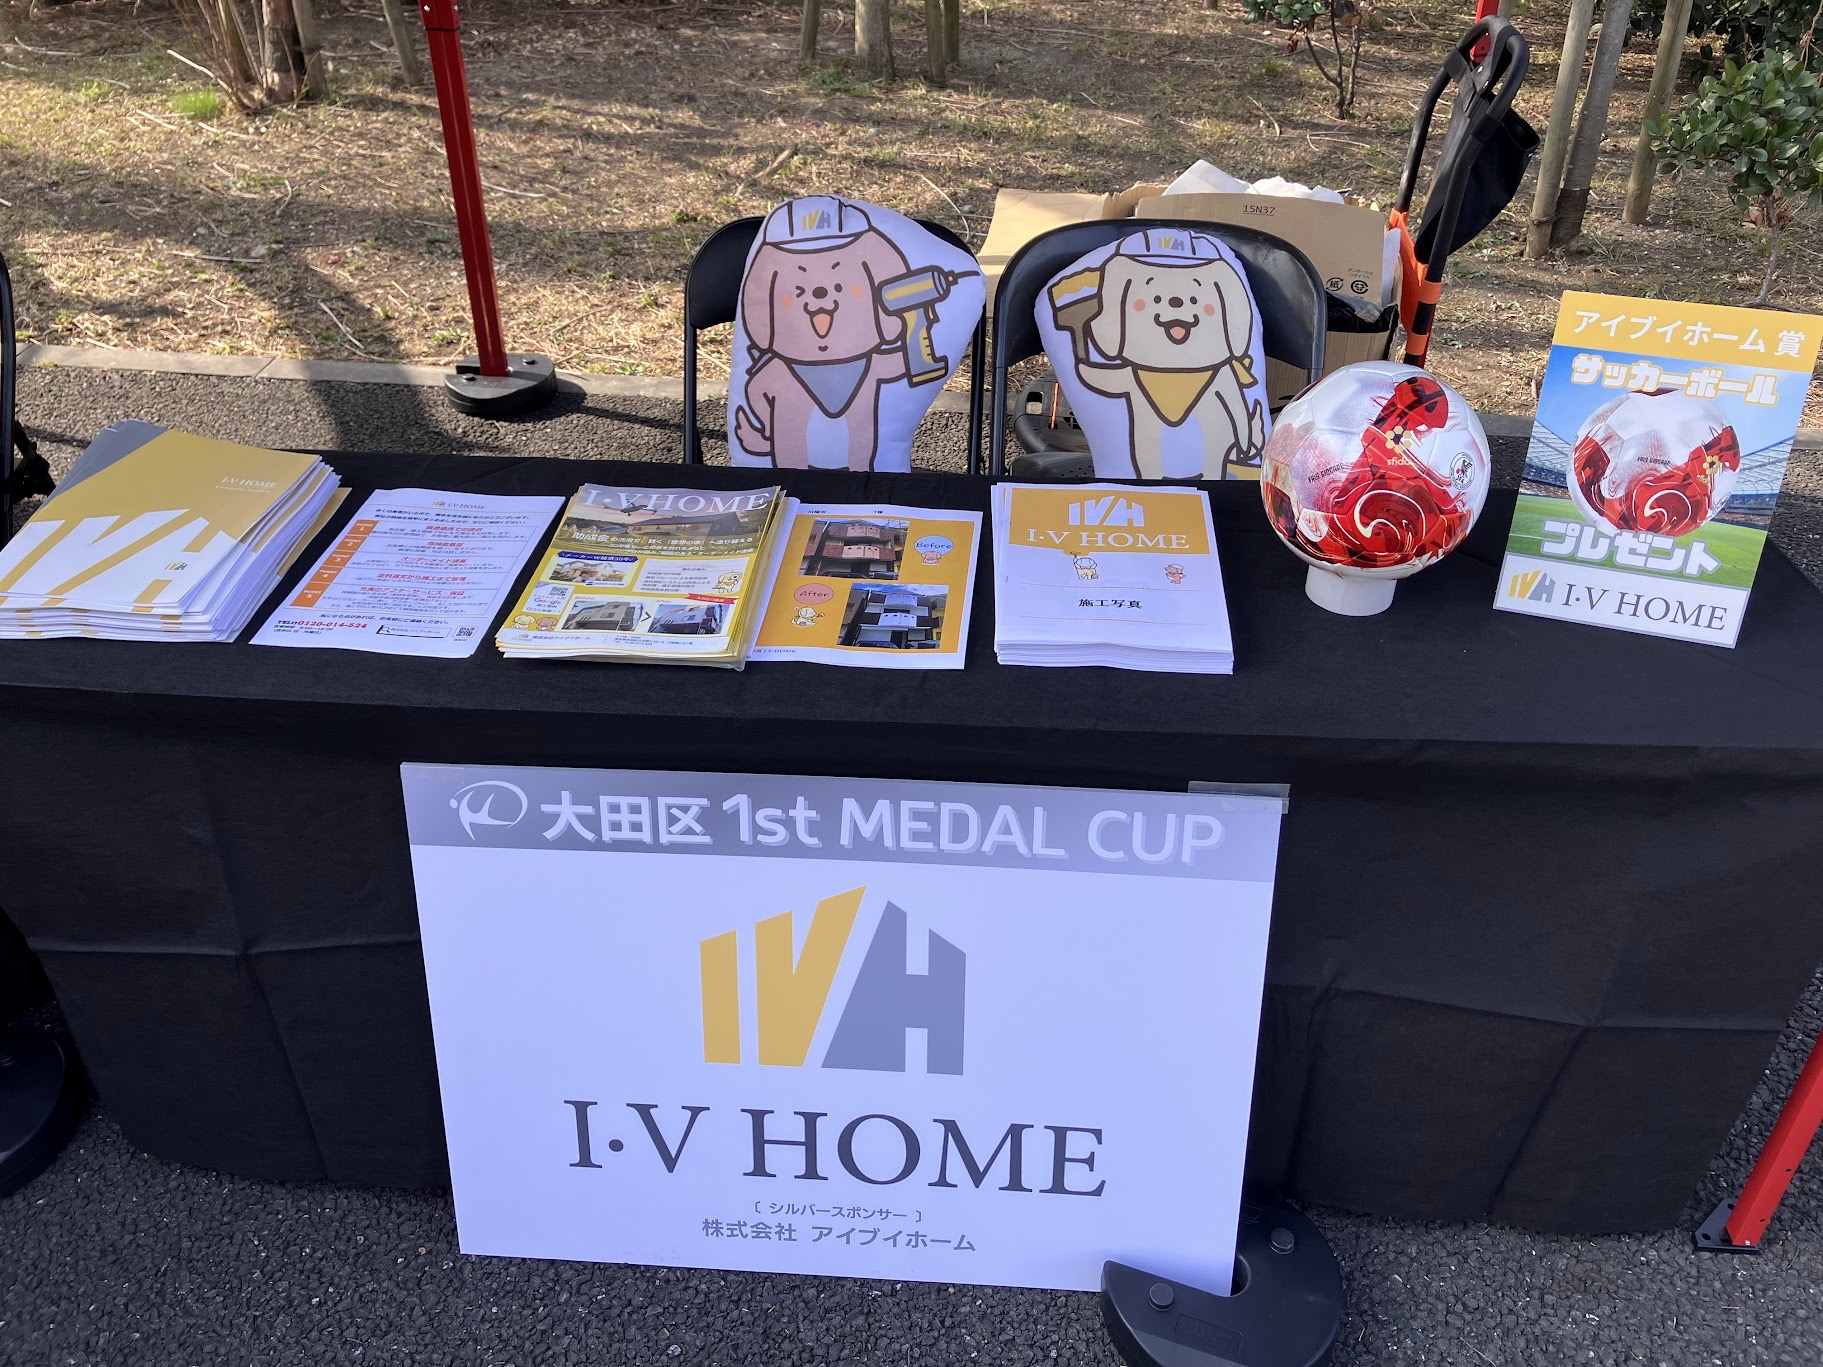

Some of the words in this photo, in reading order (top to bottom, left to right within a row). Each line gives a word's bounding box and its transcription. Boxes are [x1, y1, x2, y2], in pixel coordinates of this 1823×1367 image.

[1243, 205, 1275, 214] 15N37
[1573, 310, 1766, 353] アイブイホーム
[1774, 330, 1806, 358] 賞
[1571, 353, 1779, 406] サッカーボール
[239, 479, 278, 488] HOME
[643, 493, 770, 513] HOME
[571, 532, 610, 542] 助成金
[1080, 532, 1190, 549] HOME
[1541, 519, 1722, 576] プレゼント
[799, 590, 829, 598] After
[1078, 599, 1142, 609] 施工写真
[1613, 591, 1728, 631] HOME
[541, 790, 714, 844] 大田区
[722, 793, 822, 848] 1st
[839, 797, 1069, 860] MEDAL
[1087, 809, 1226, 866] CUP
[740, 1107, 1107, 1197] HOME
[701, 1218, 798, 1243] 株式会社
[811, 1224, 977, 1252] アイブイホーム
